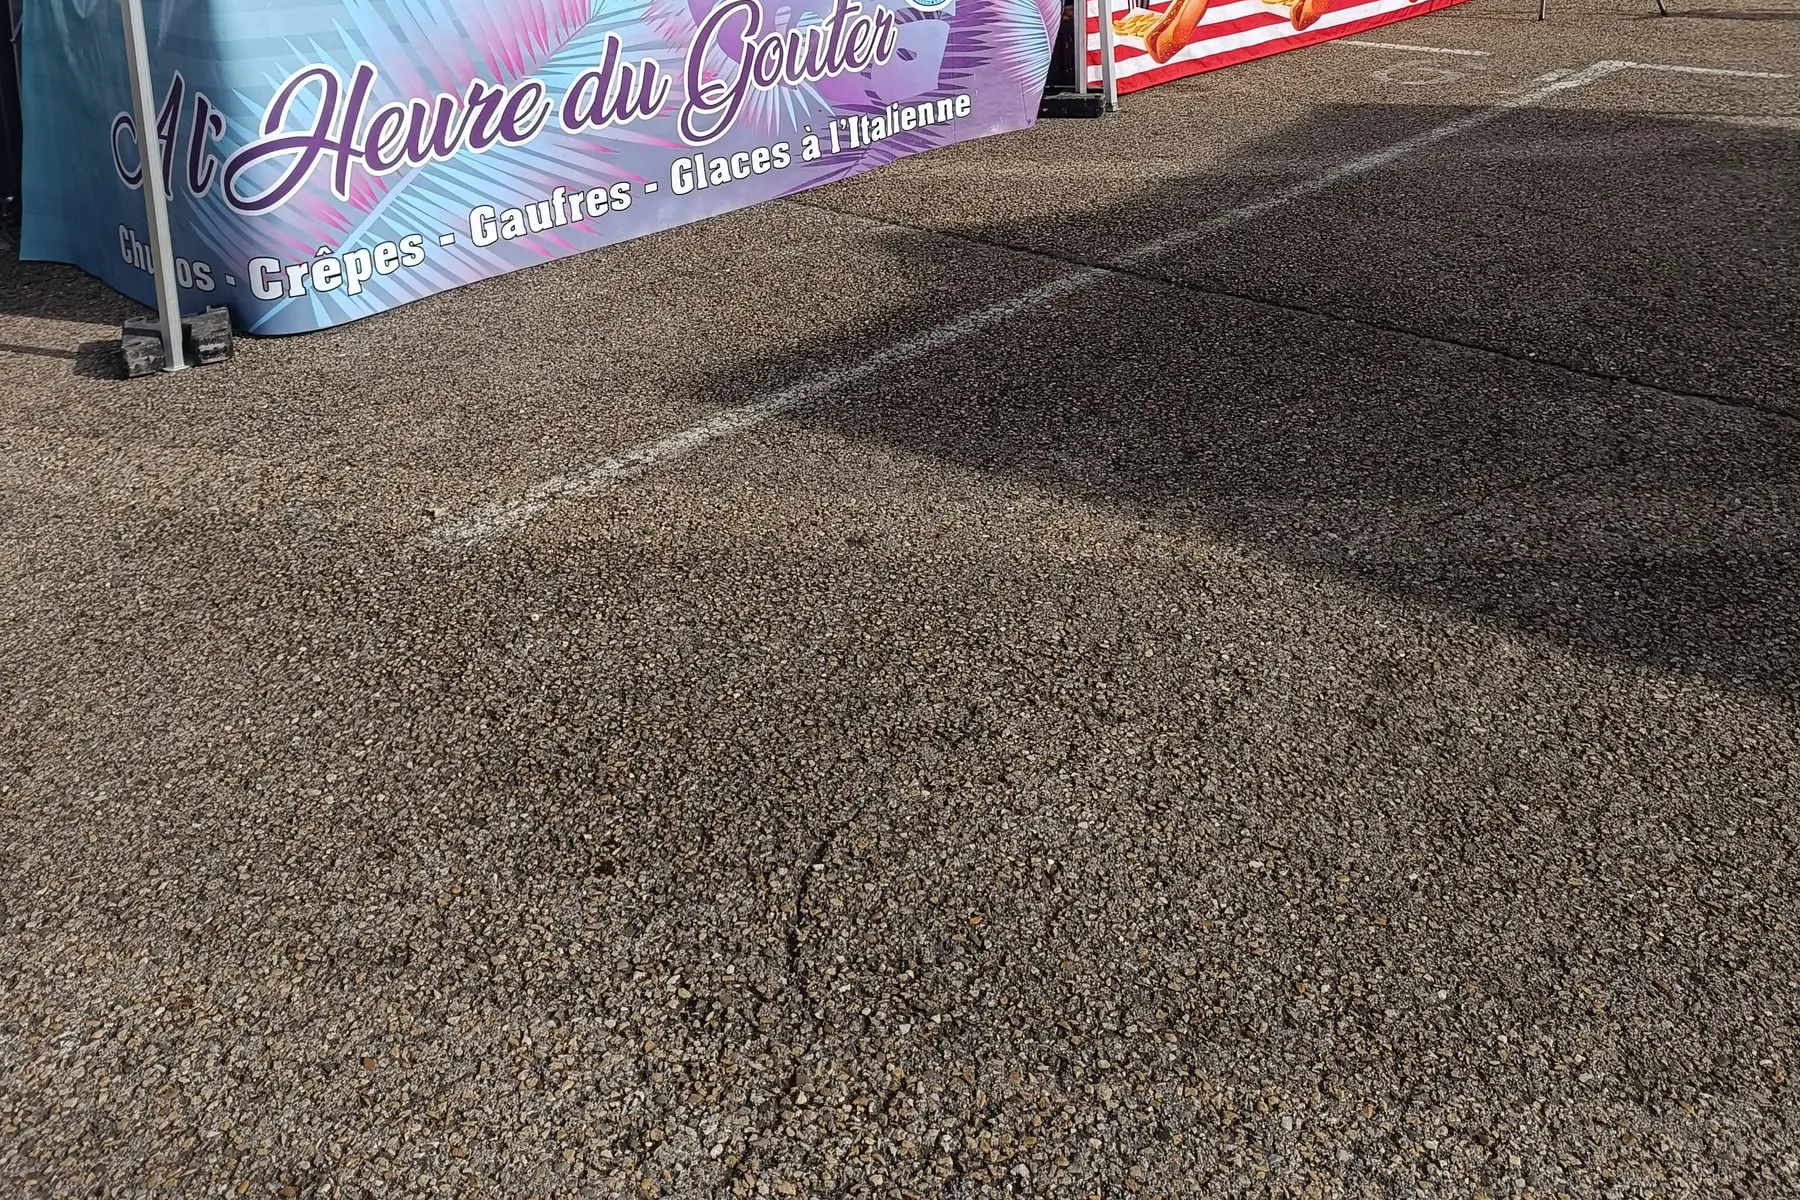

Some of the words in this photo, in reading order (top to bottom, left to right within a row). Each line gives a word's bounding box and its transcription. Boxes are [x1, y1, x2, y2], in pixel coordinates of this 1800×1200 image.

[559, 30, 673, 133] du
[248, 230, 427, 303] Crêpes
[469, 180, 633, 249] Gaufres
[669, 141, 792, 197] Glaces
[800, 125, 823, 162] à
[829, 93, 973, 155] l'Italienne
